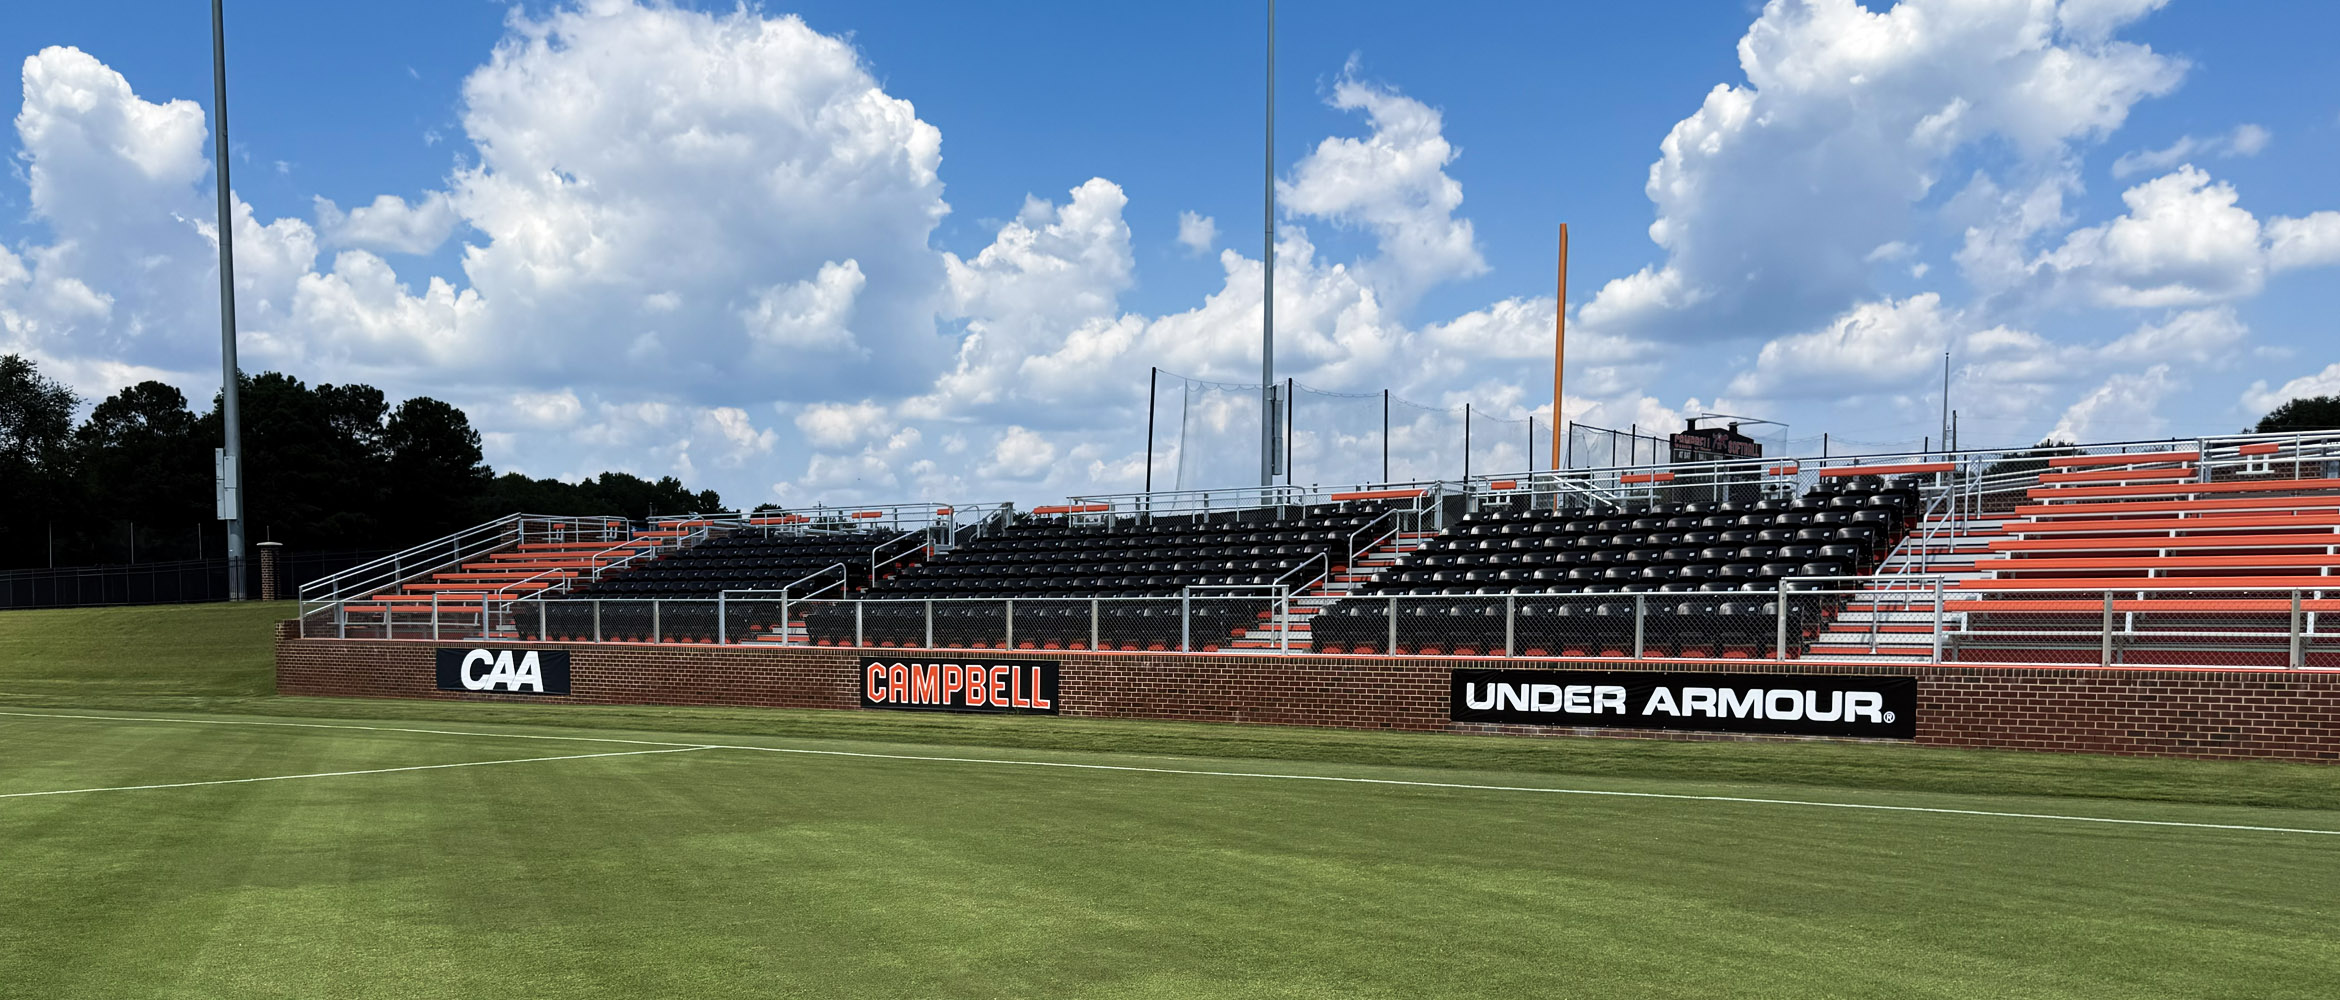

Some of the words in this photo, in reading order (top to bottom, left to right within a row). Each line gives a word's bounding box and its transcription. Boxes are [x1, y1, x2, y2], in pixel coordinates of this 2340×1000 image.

[1728, 440, 1761, 458] SOFTBALL
[461, 648, 544, 692] CAA
[867, 662, 1051, 709] CAMPBELL
[1465, 682, 1627, 715] UNDER
